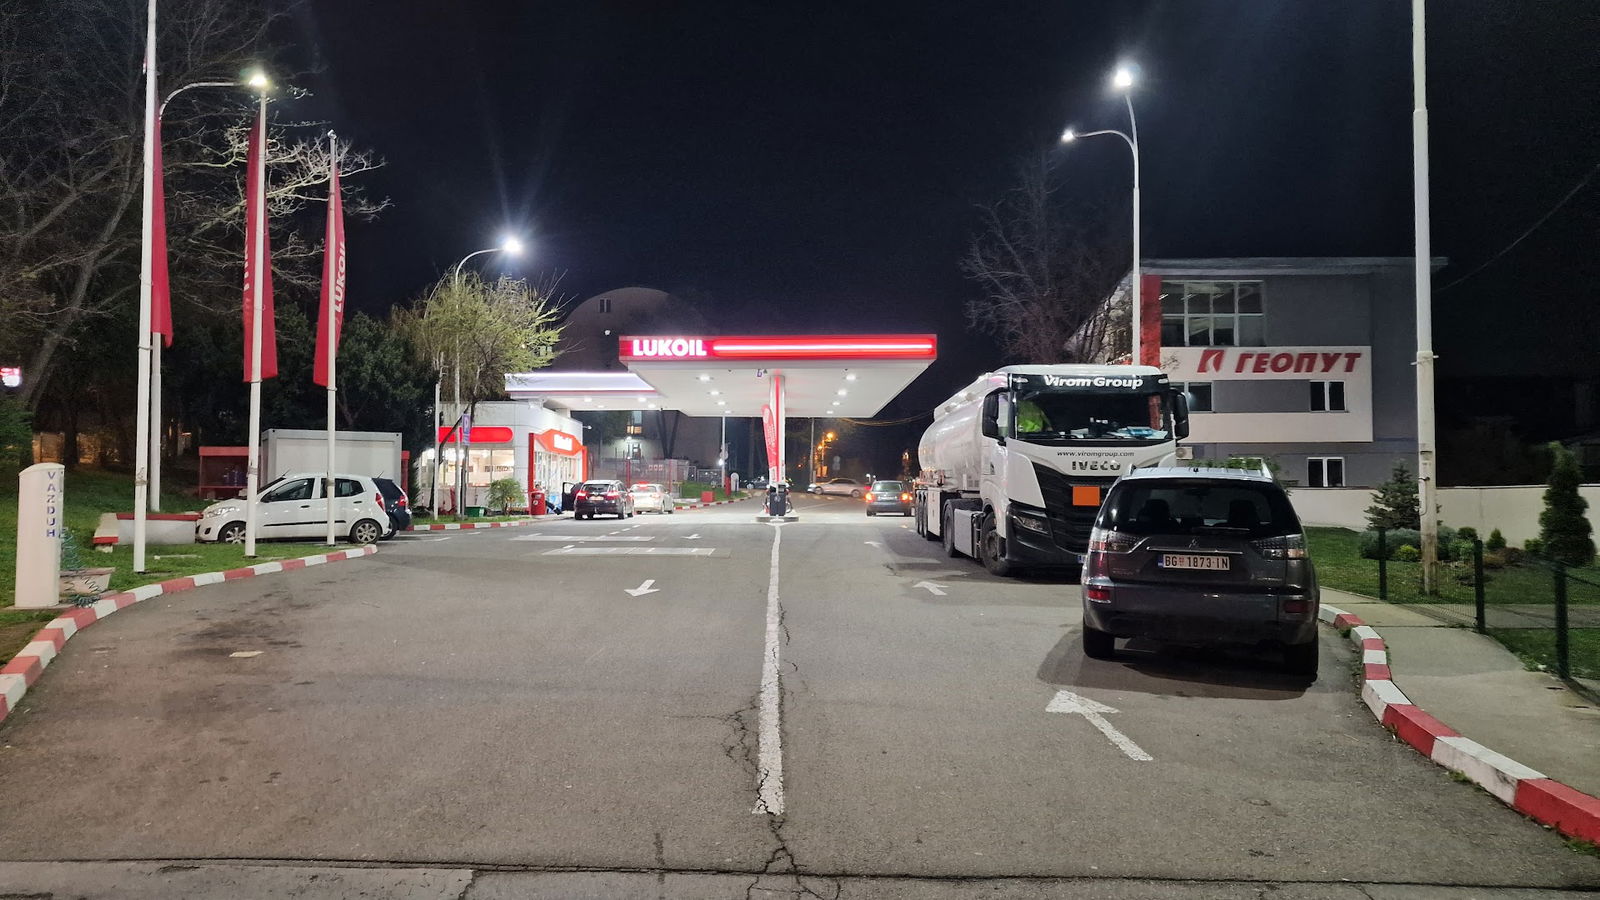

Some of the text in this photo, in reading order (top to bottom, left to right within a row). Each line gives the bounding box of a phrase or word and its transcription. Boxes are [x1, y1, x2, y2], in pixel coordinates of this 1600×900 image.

[633, 339, 707, 356] LUKOIL
[1235, 352, 1362, 373] ГЕОПУТ
[1044, 374, 1143, 390] Virom Group
[1057, 450, 1135, 458] www.viromgroup.com
[1072, 460, 1121, 471] IVECO
[47, 471, 56, 537] VAZDUH
[1165, 555, 1178, 567] BG
